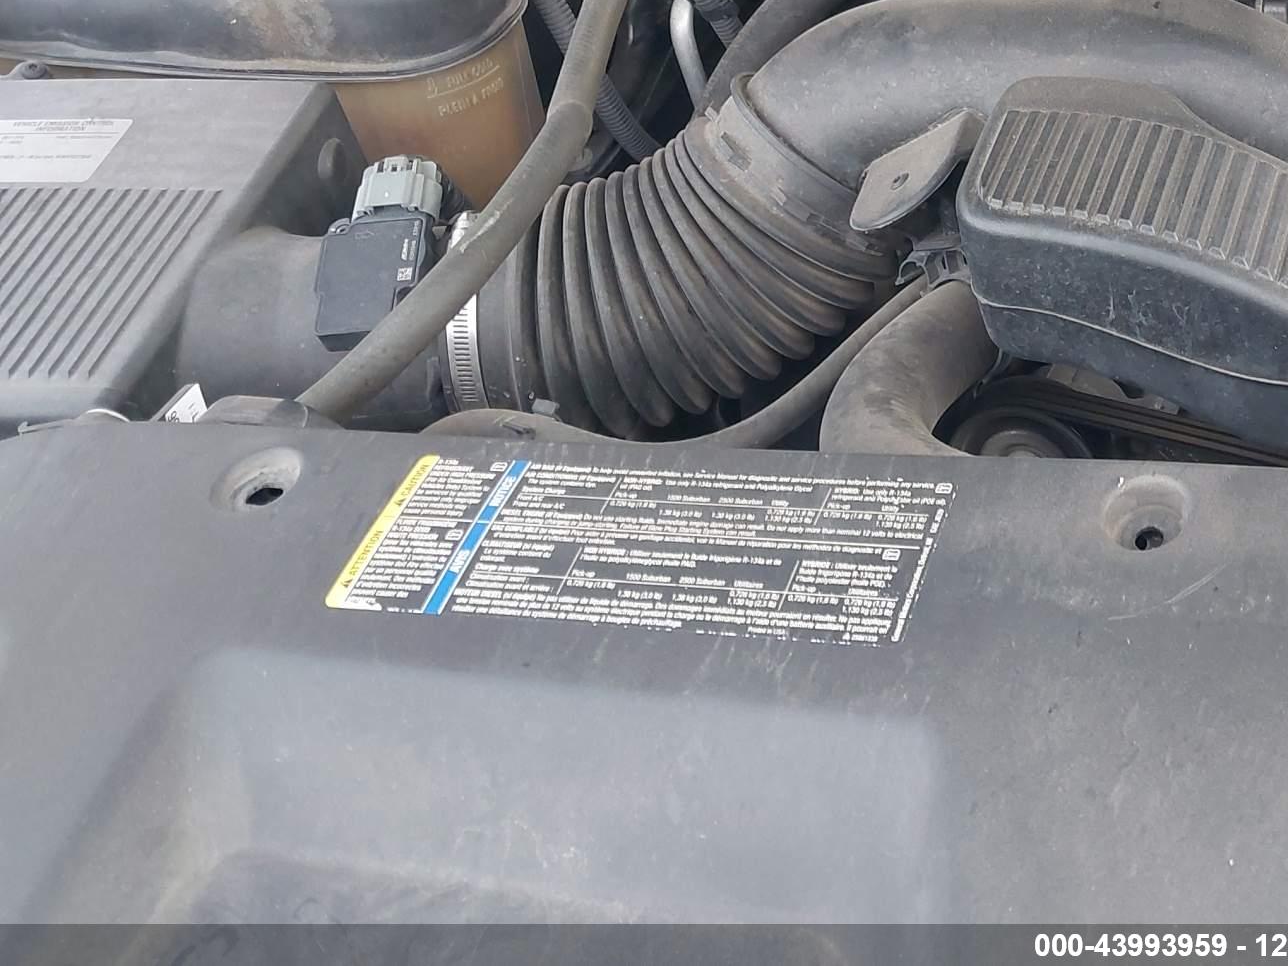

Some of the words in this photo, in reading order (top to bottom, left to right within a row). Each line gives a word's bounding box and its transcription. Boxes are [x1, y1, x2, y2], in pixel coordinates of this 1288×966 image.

[488, 476, 516, 506] NOTICE
[346, 530, 383, 575] ATTENTION
[446, 549, 471, 572] AVIS
